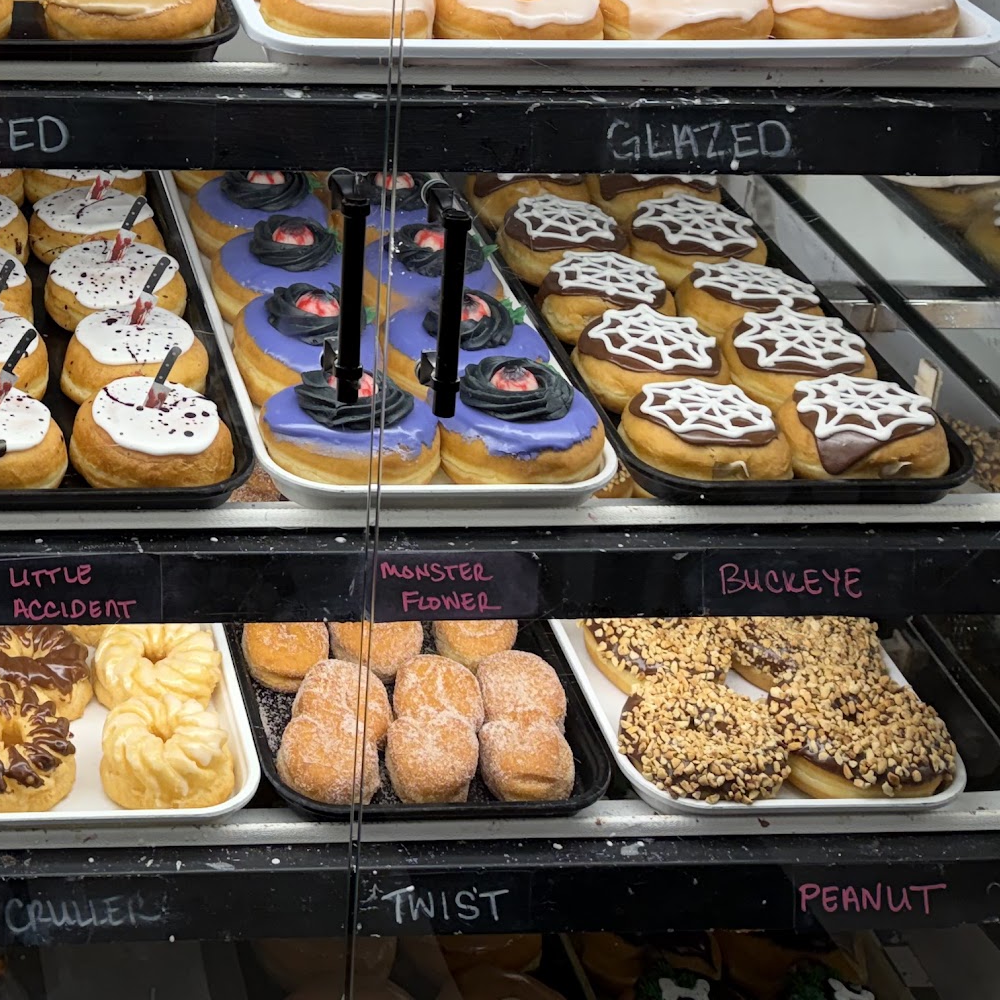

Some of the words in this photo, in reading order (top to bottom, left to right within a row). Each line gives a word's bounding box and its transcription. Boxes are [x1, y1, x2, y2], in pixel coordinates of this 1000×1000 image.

[606, 119, 793, 161] GLAZED
[380, 563, 493, 583] MONSTER
[719, 563, 864, 599] BUCKEYE
[13, 598, 137, 621] ACCIDENT
[402, 591, 503, 613] FLOWER
[4, 895, 164, 934] CRULLER
[381, 886, 509, 923] TWIST
[799, 883, 947, 914] PEANUT
